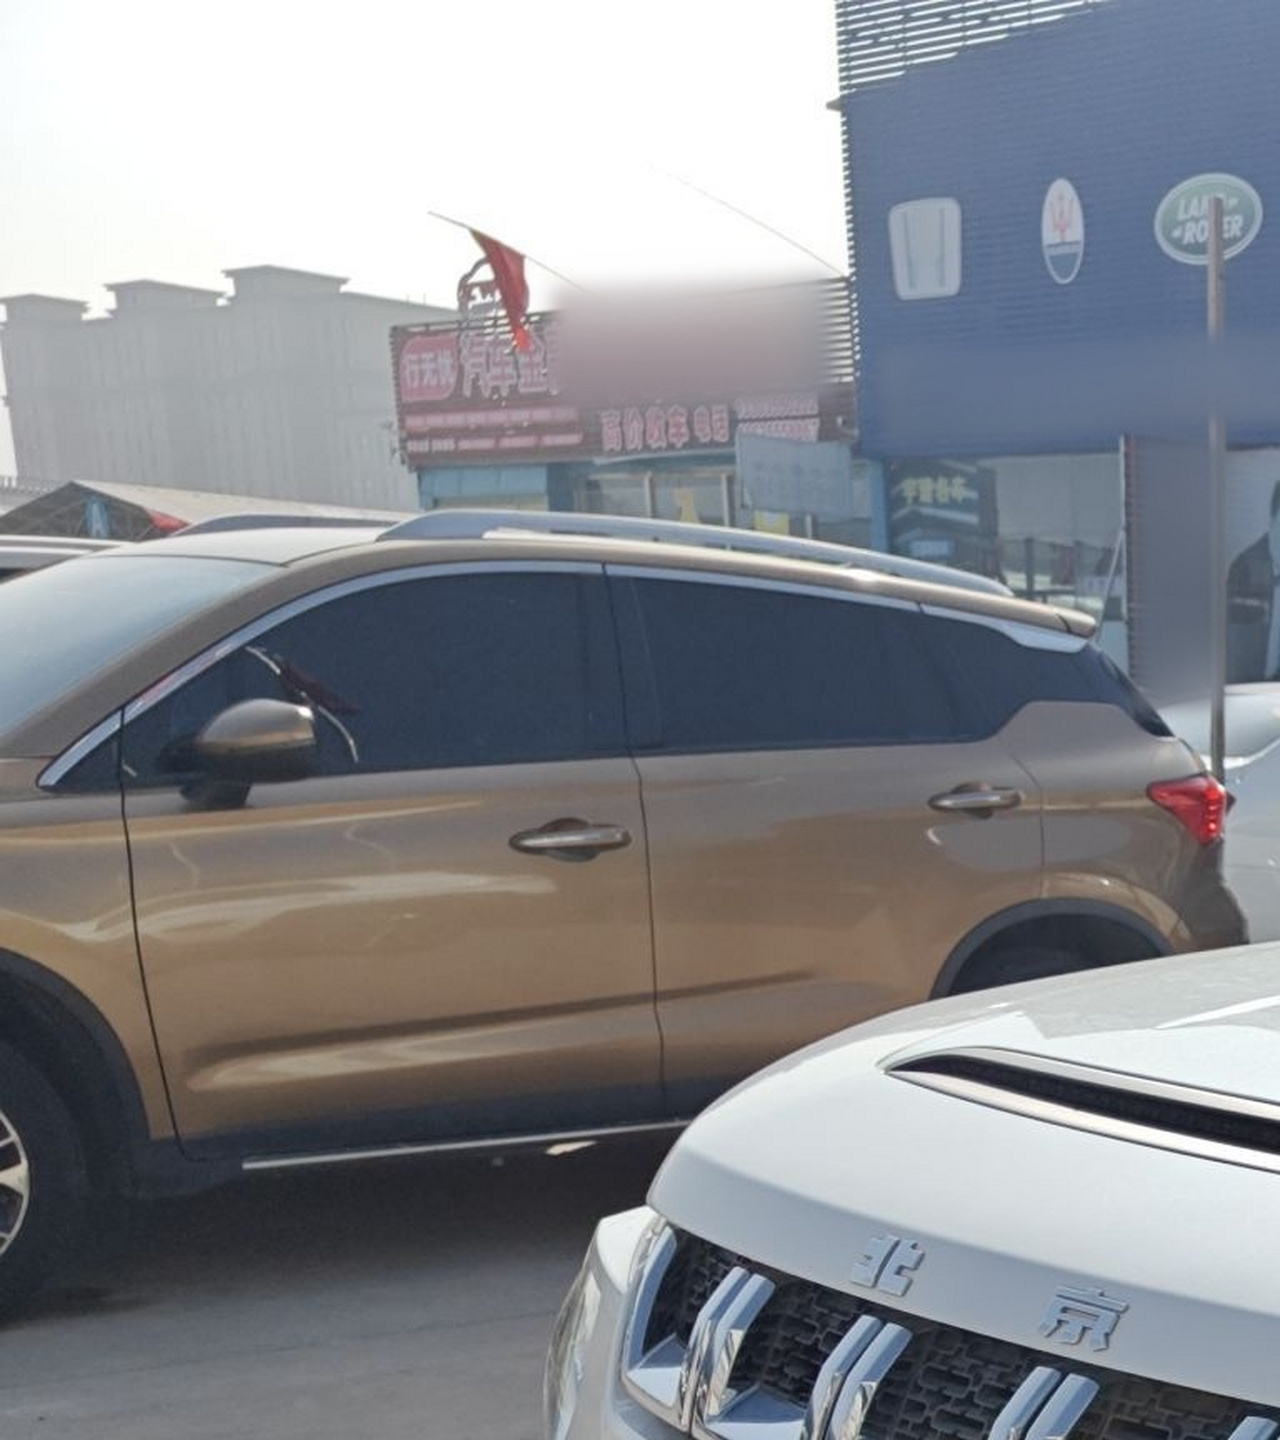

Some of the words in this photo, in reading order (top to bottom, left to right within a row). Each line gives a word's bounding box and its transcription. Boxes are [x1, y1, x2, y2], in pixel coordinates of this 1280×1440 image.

[1182, 214, 1244, 246] ROER
[601, 404, 690, 451] 高价收车
[850, 1234, 1130, 1352] 北京
